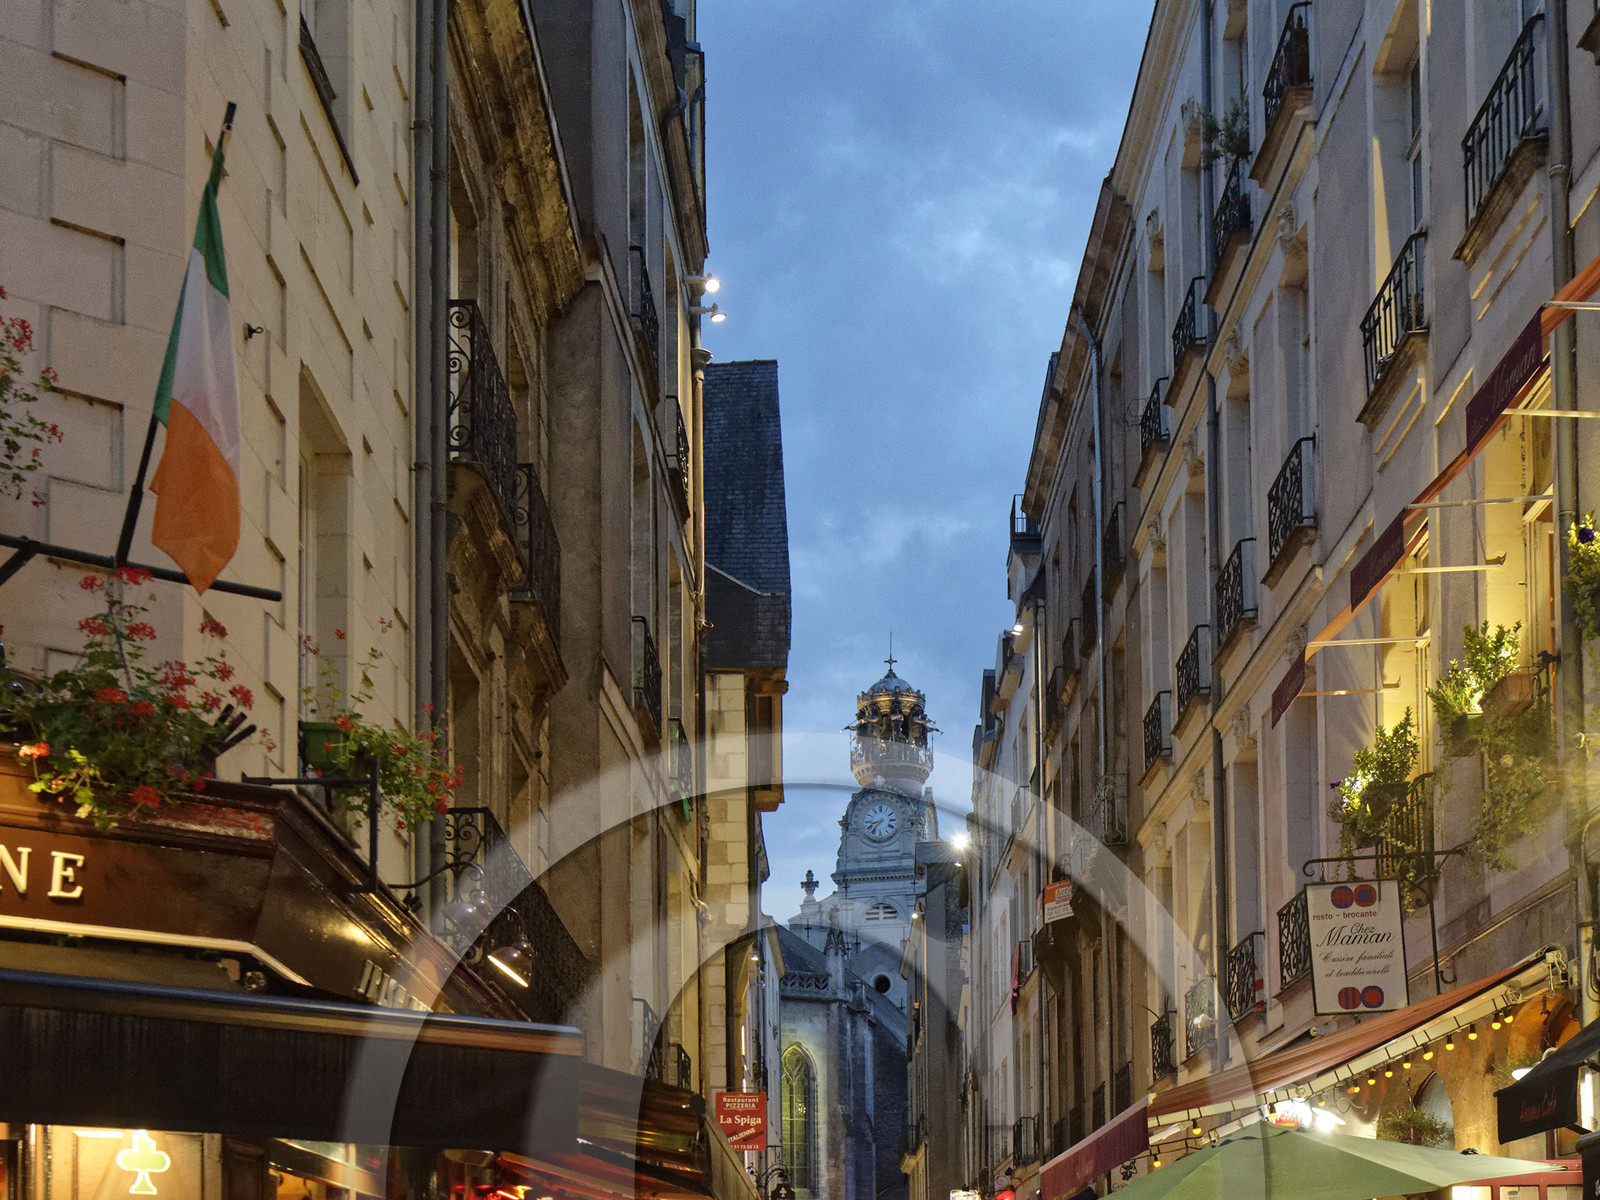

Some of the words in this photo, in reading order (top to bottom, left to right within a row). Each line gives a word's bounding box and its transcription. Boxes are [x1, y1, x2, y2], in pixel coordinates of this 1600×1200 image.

[0, 844, 84, 898] NE
[1313, 912, 1333, 920] resto
[1343, 910, 1377, 919] brocante
[1350, 923, 1376, 934] Chez
[1316, 925, 1395, 947] Maman
[1319, 952, 1355, 963] Cuisine
[1325, 968, 1335, 978] et
[720, 1115, 732, 1124] La
[734, 1115, 762, 1126] Spiga
[727, 1127, 756, 1143] ITALIENNE
